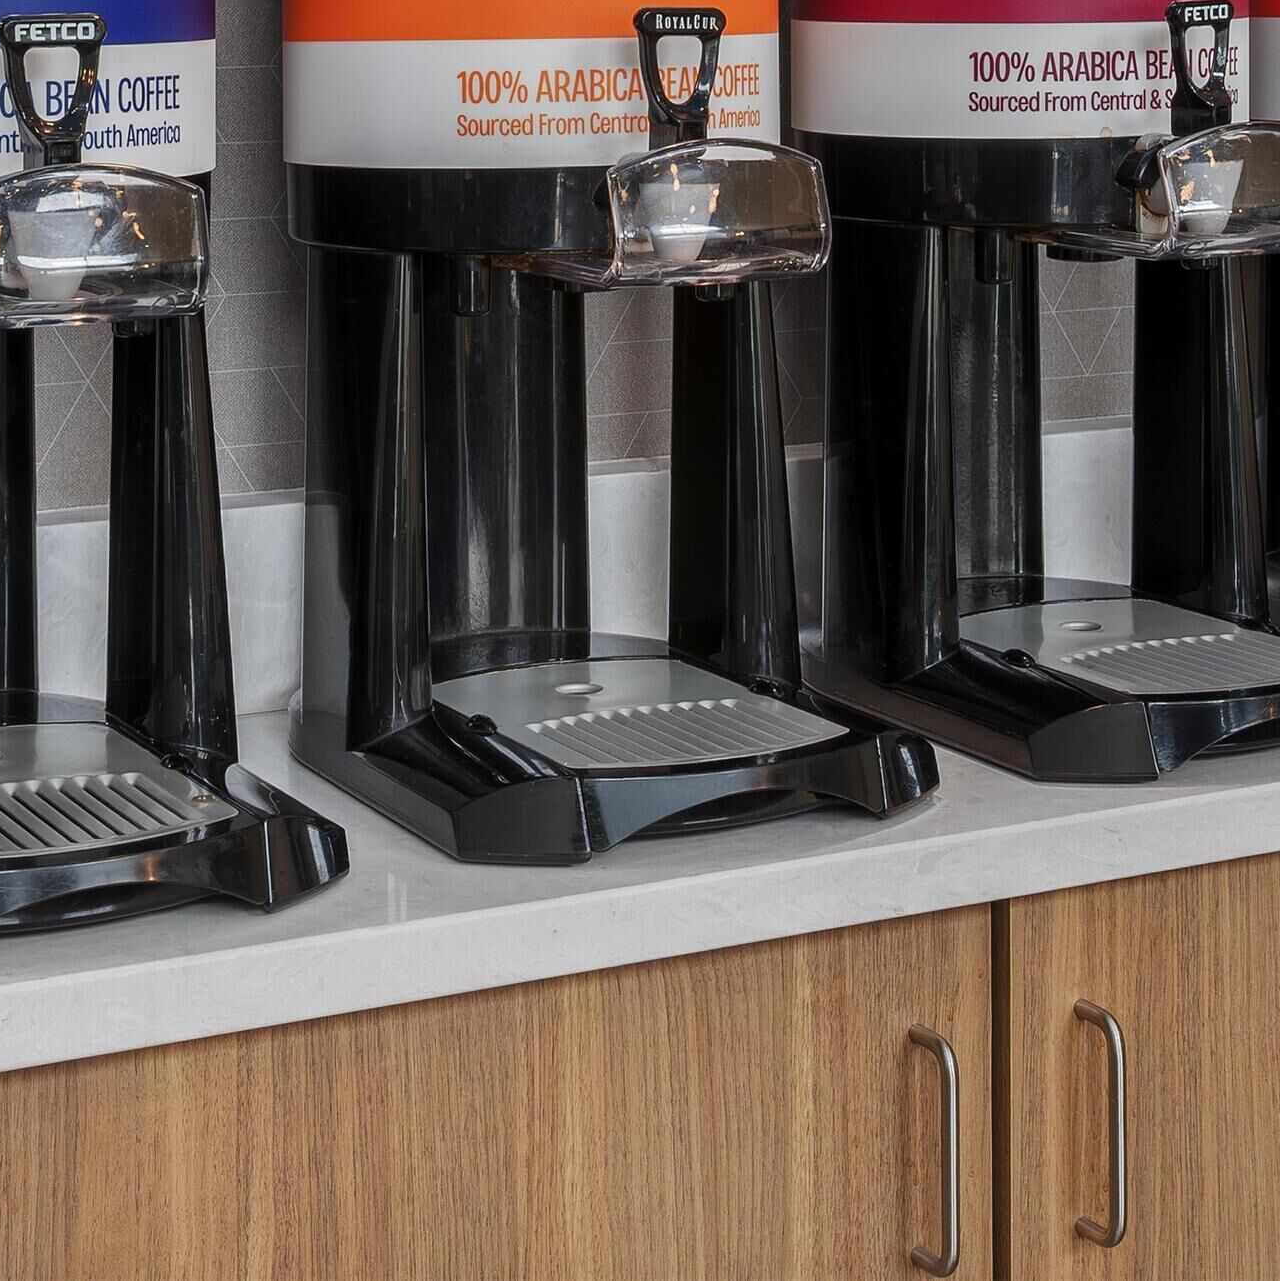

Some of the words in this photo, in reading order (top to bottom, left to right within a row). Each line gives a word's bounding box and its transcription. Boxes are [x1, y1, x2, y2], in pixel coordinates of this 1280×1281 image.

[1184, 4, 1229, 22] FETCO
[14, 21, 96, 42] FETCO
[969, 51, 1035, 82] 100%
[1041, 50, 1139, 82] ARABICA
[46, 78, 110, 117] BEN
[118, 74, 181, 114] COFFEE
[456, 70, 529, 105] 100%
[535, 67, 644, 103] ARABICA
[969, 91, 1040, 113] Sourced
[1044, 91, 1087, 111] From
[1091, 89, 1146, 111] Central
[1150, 89, 1162, 110] &
[456, 113, 534, 137] Sourced
[539, 113, 585, 135] From
[590, 111, 649, 134] Centra
[718, 106, 761, 129] America
[81, 123, 122, 150] outh
[126, 120, 181, 146] America
